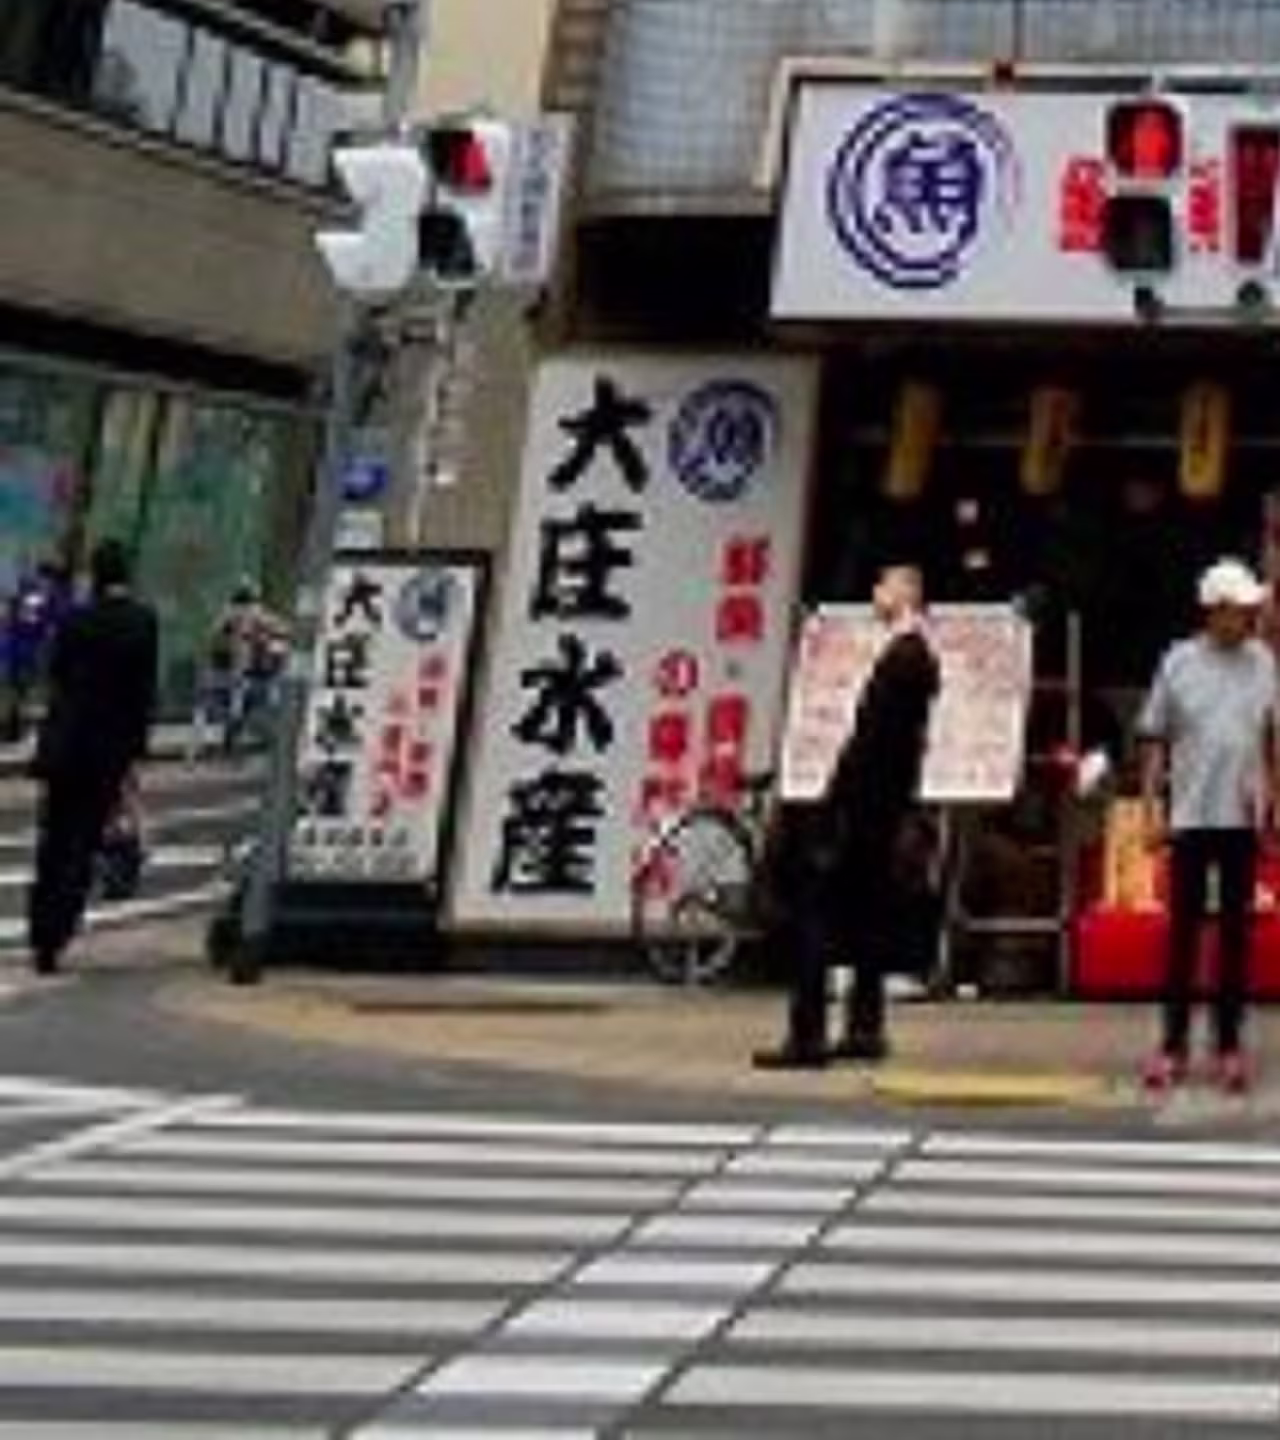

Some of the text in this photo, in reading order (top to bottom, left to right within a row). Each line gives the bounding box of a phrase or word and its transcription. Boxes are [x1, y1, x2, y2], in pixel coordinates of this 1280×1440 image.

[298, 574, 383, 818] 大庄水産
[492, 375, 652, 895] 大庄水産
